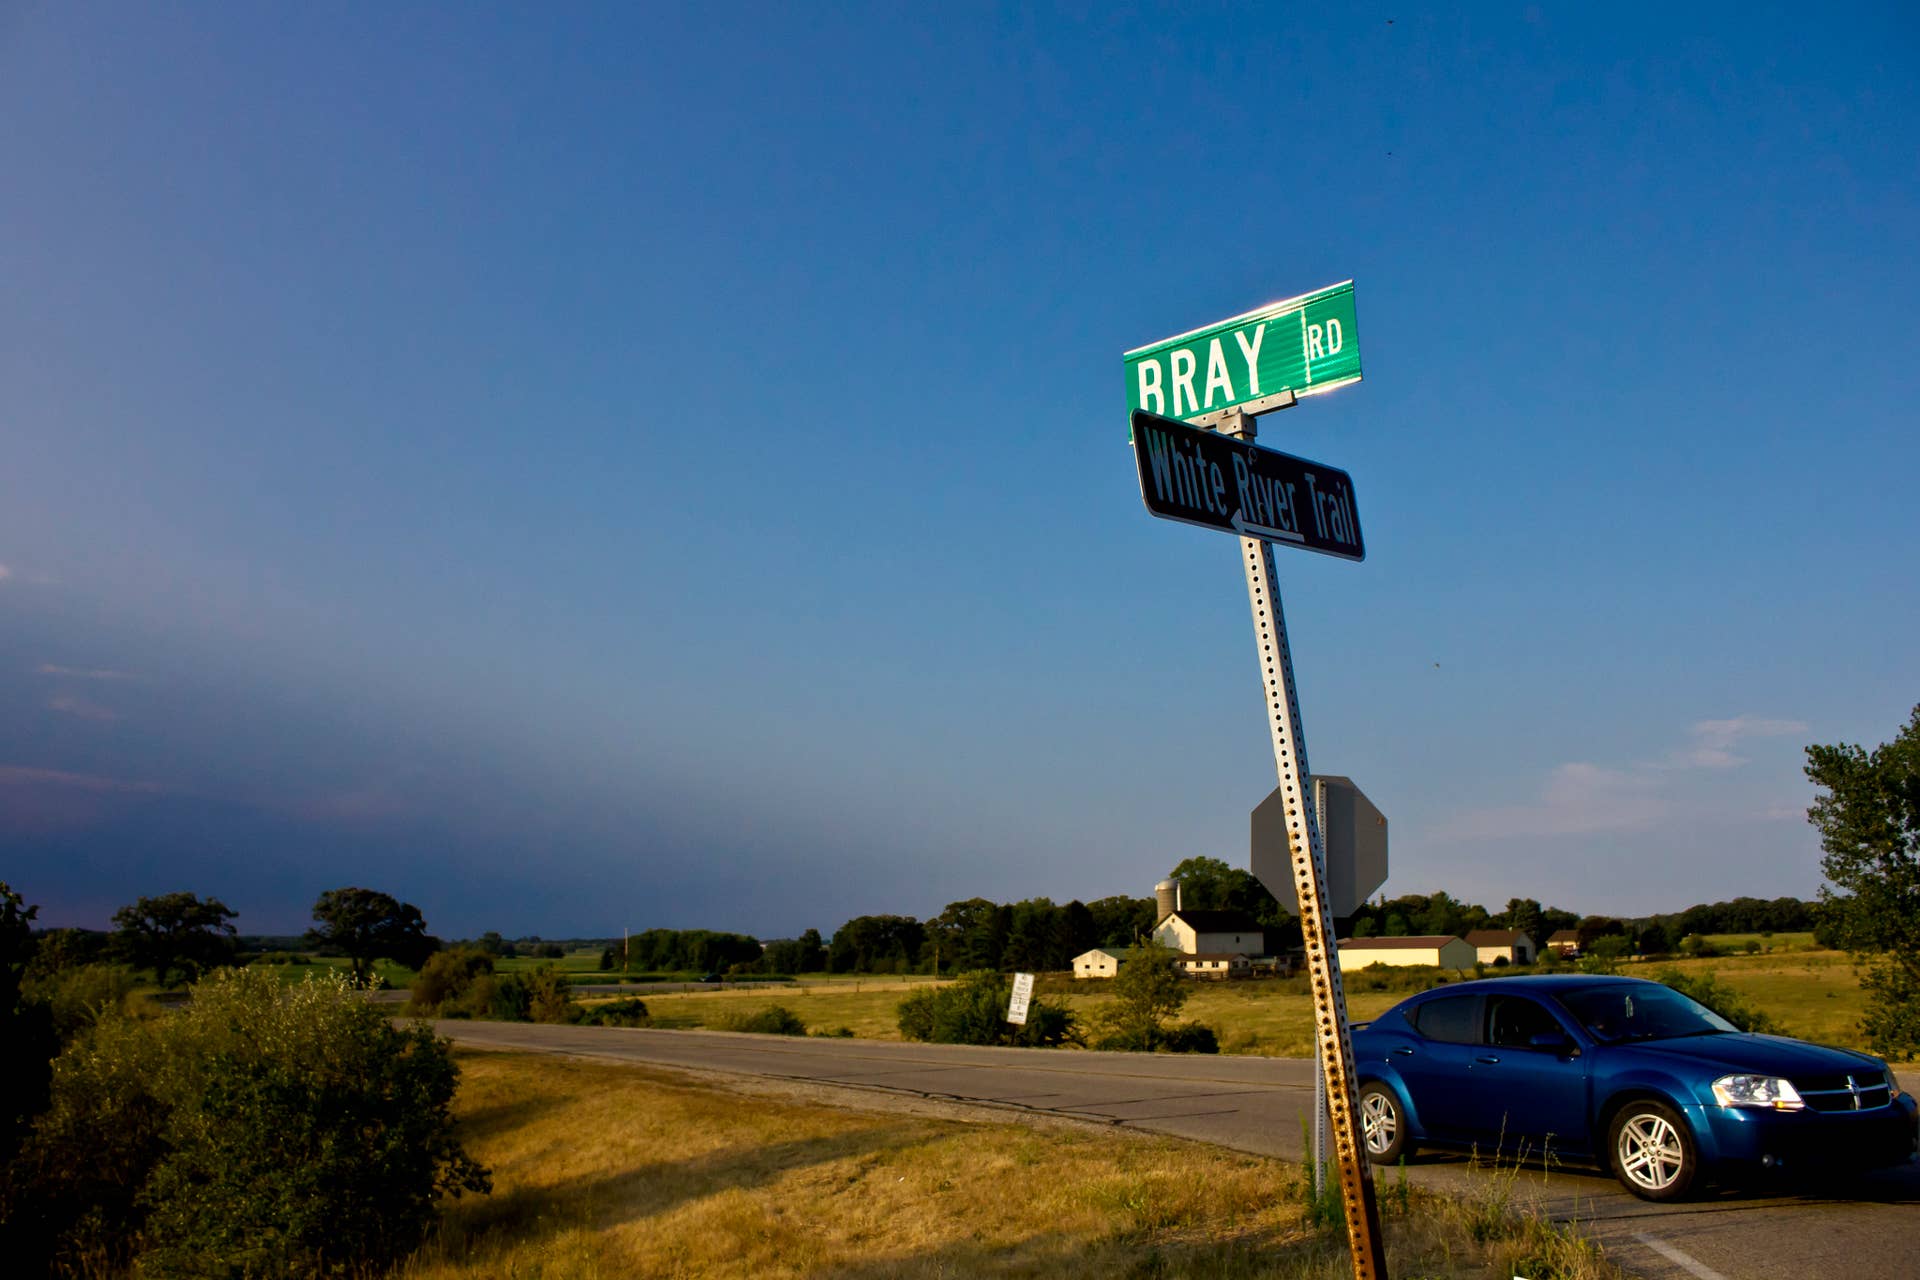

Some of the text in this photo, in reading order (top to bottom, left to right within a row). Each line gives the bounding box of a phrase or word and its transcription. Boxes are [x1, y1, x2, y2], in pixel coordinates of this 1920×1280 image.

[1138, 318, 1343, 417] BRAY RD
[1144, 426, 1357, 546] White River Trail
